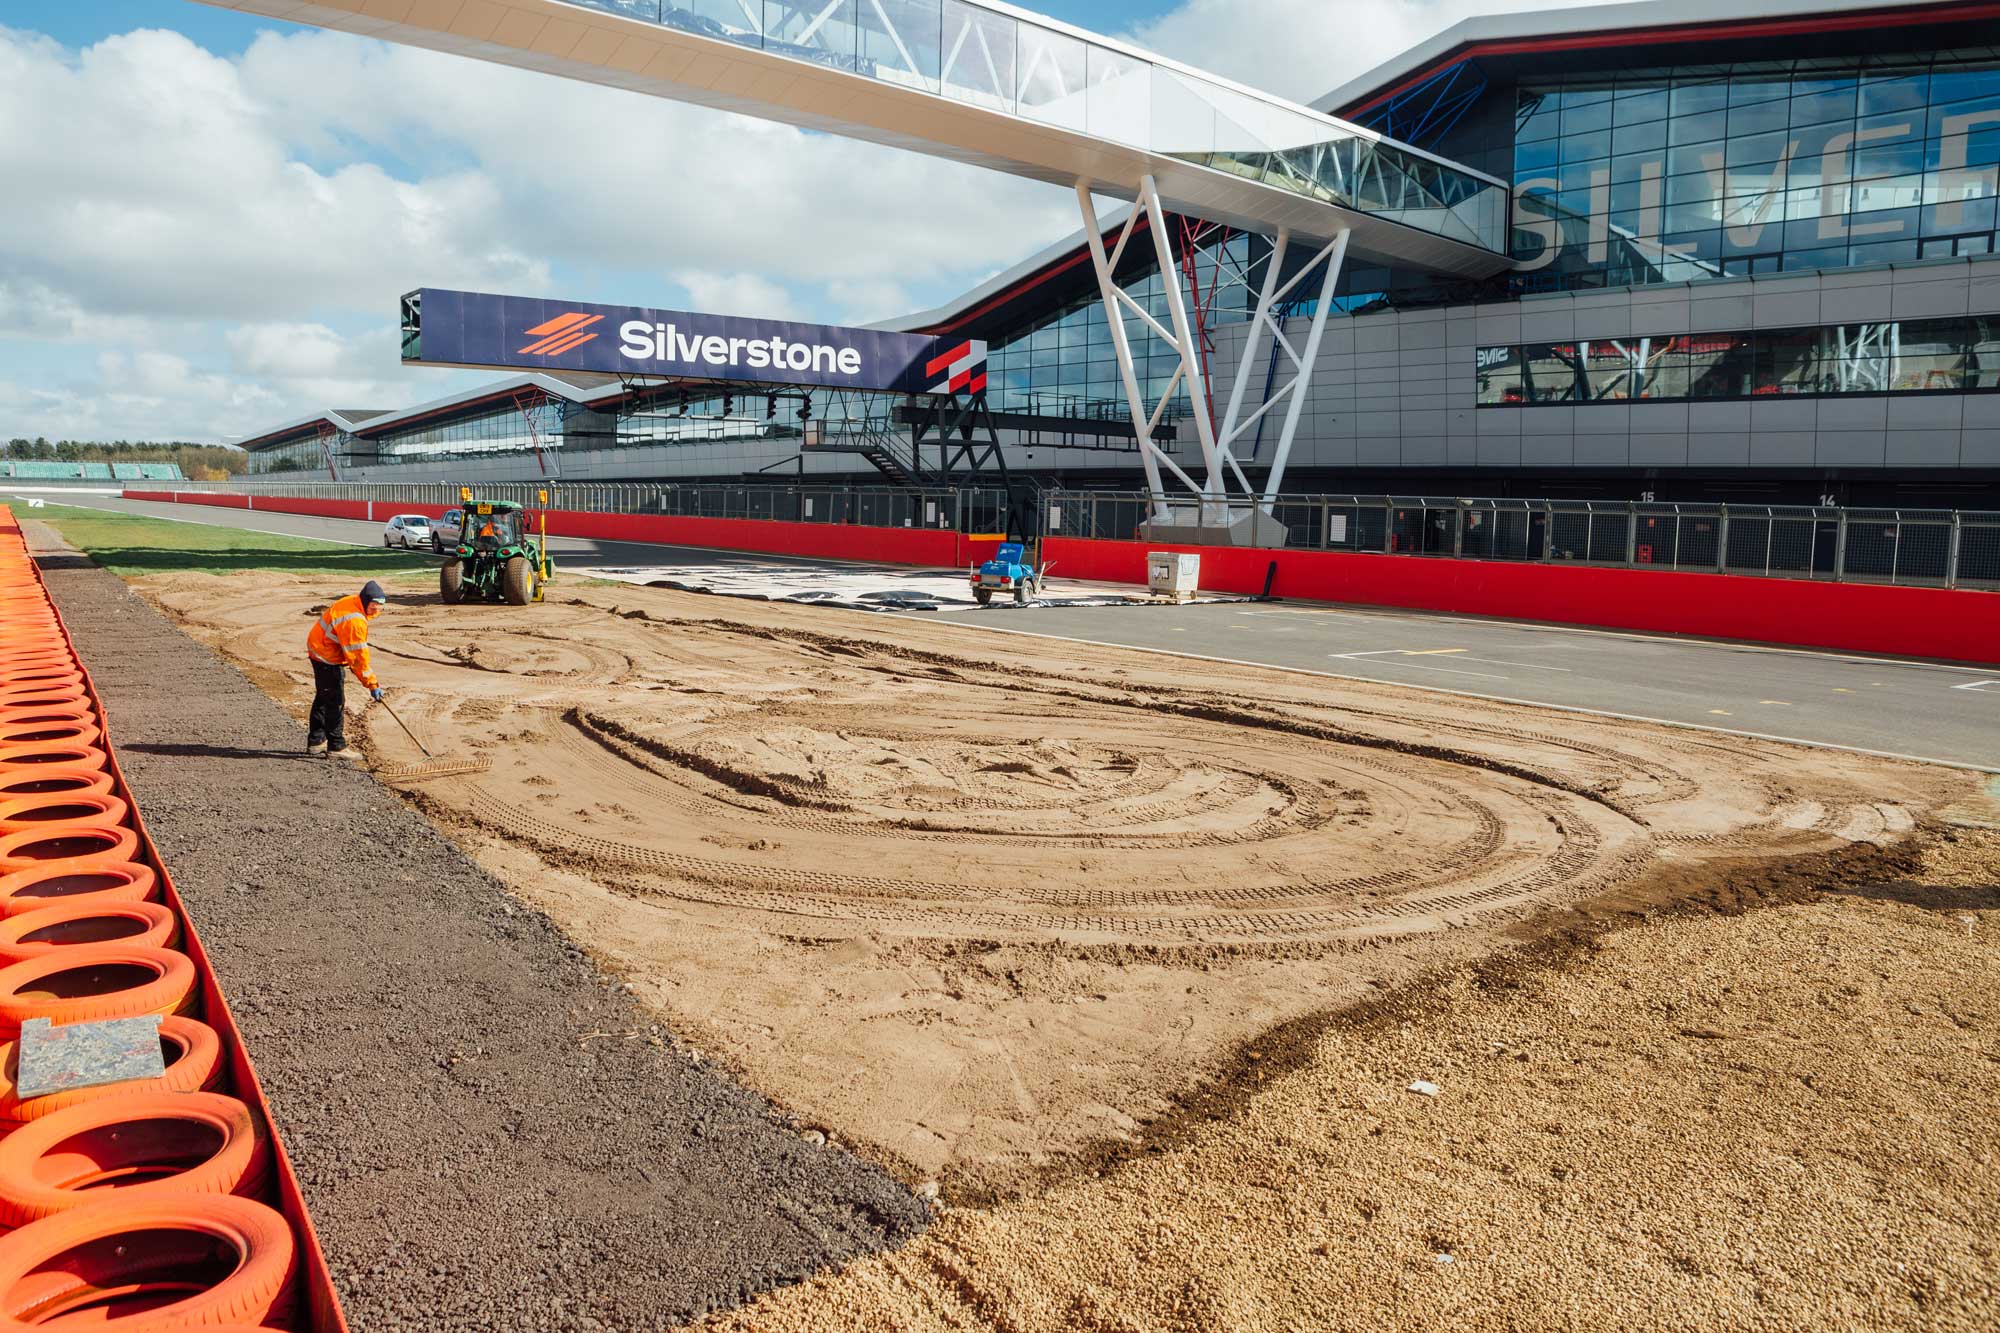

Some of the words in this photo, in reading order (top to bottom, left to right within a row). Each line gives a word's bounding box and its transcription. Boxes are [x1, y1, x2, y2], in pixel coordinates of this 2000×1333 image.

[619, 320, 861, 374] Silverstone
[1641, 491, 1655, 503] 15
[1820, 494, 1835, 507] 14
